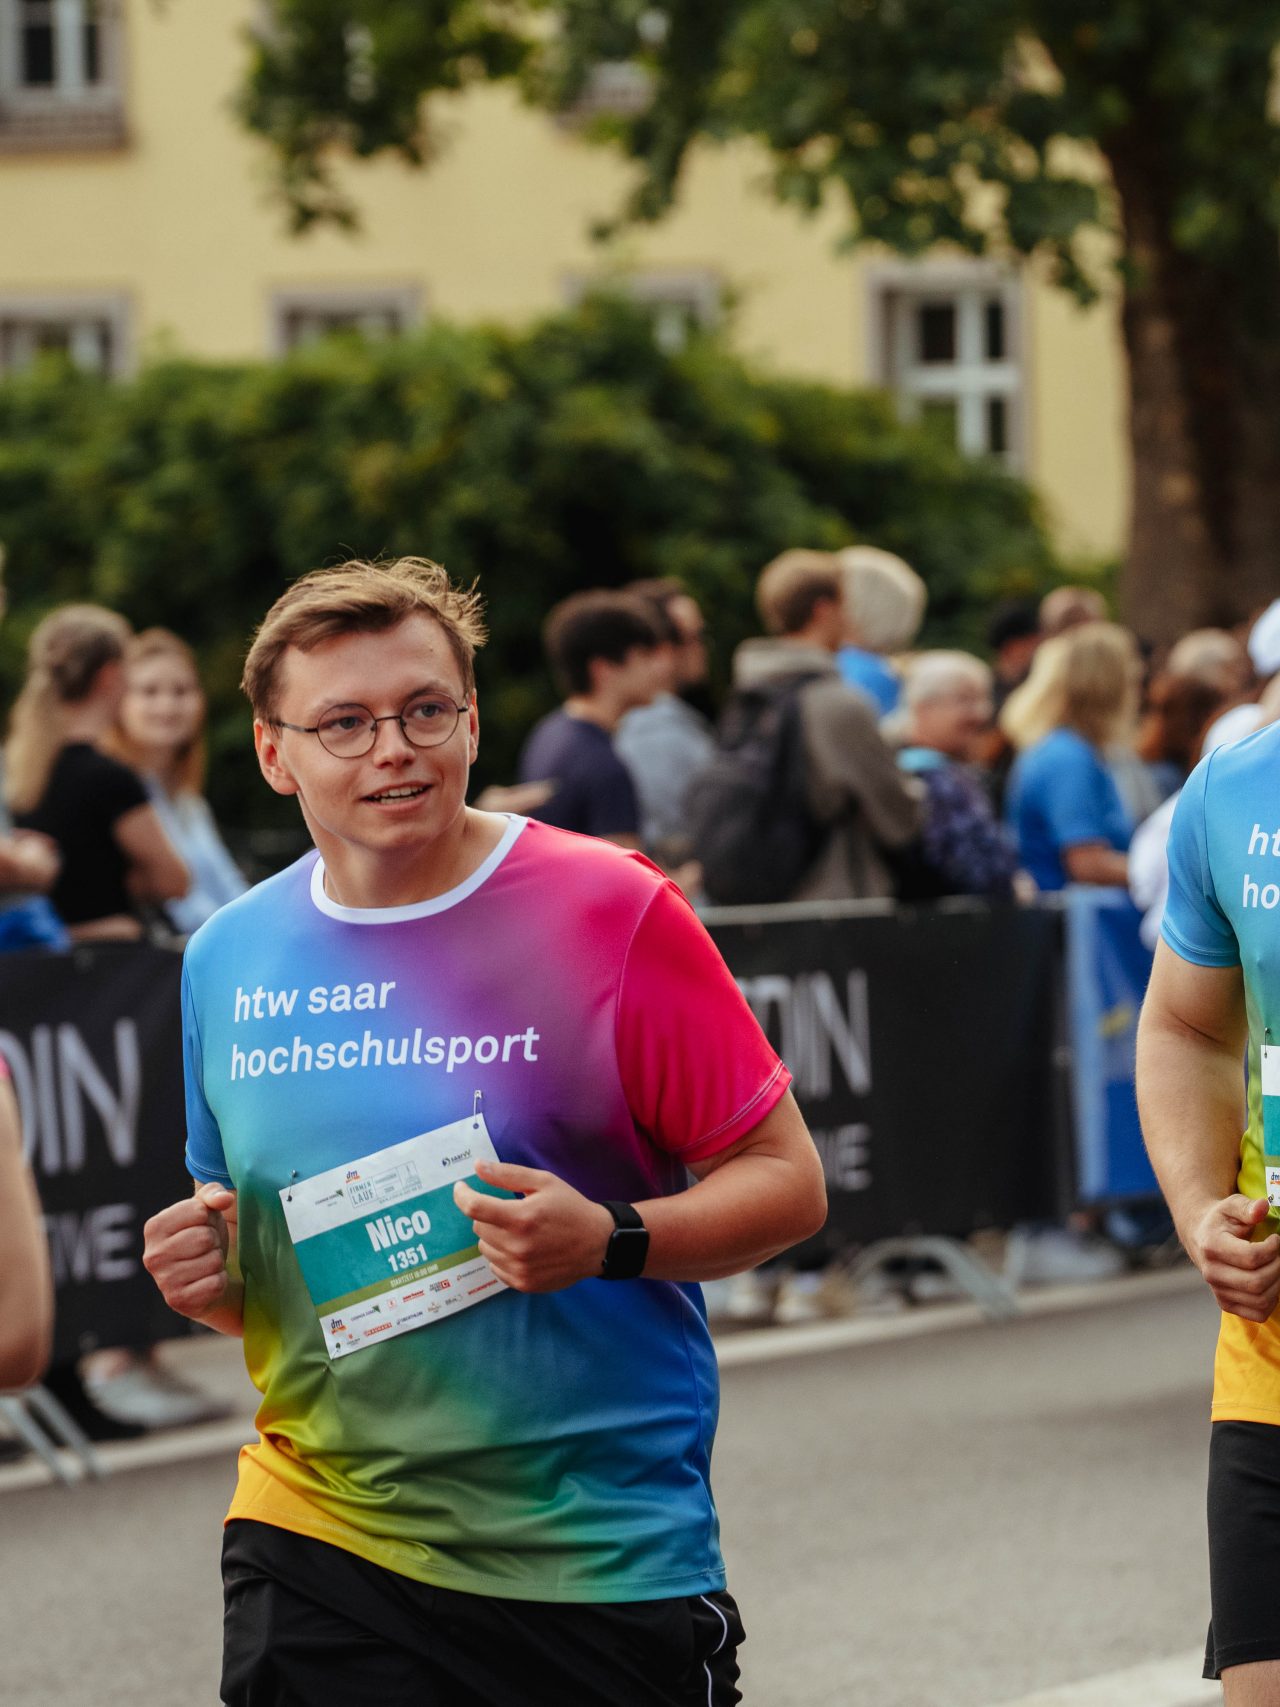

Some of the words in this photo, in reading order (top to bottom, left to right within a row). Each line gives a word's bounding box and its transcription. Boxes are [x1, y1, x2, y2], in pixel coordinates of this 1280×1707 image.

[234, 985, 299, 1023] htw
[307, 981, 396, 1014] saar
[230, 1026, 540, 1081] hochschulsport
[352, 1189, 374, 1206] LAUF
[364, 1210, 431, 1252] Nico
[388, 1243, 428, 1272] 1351
